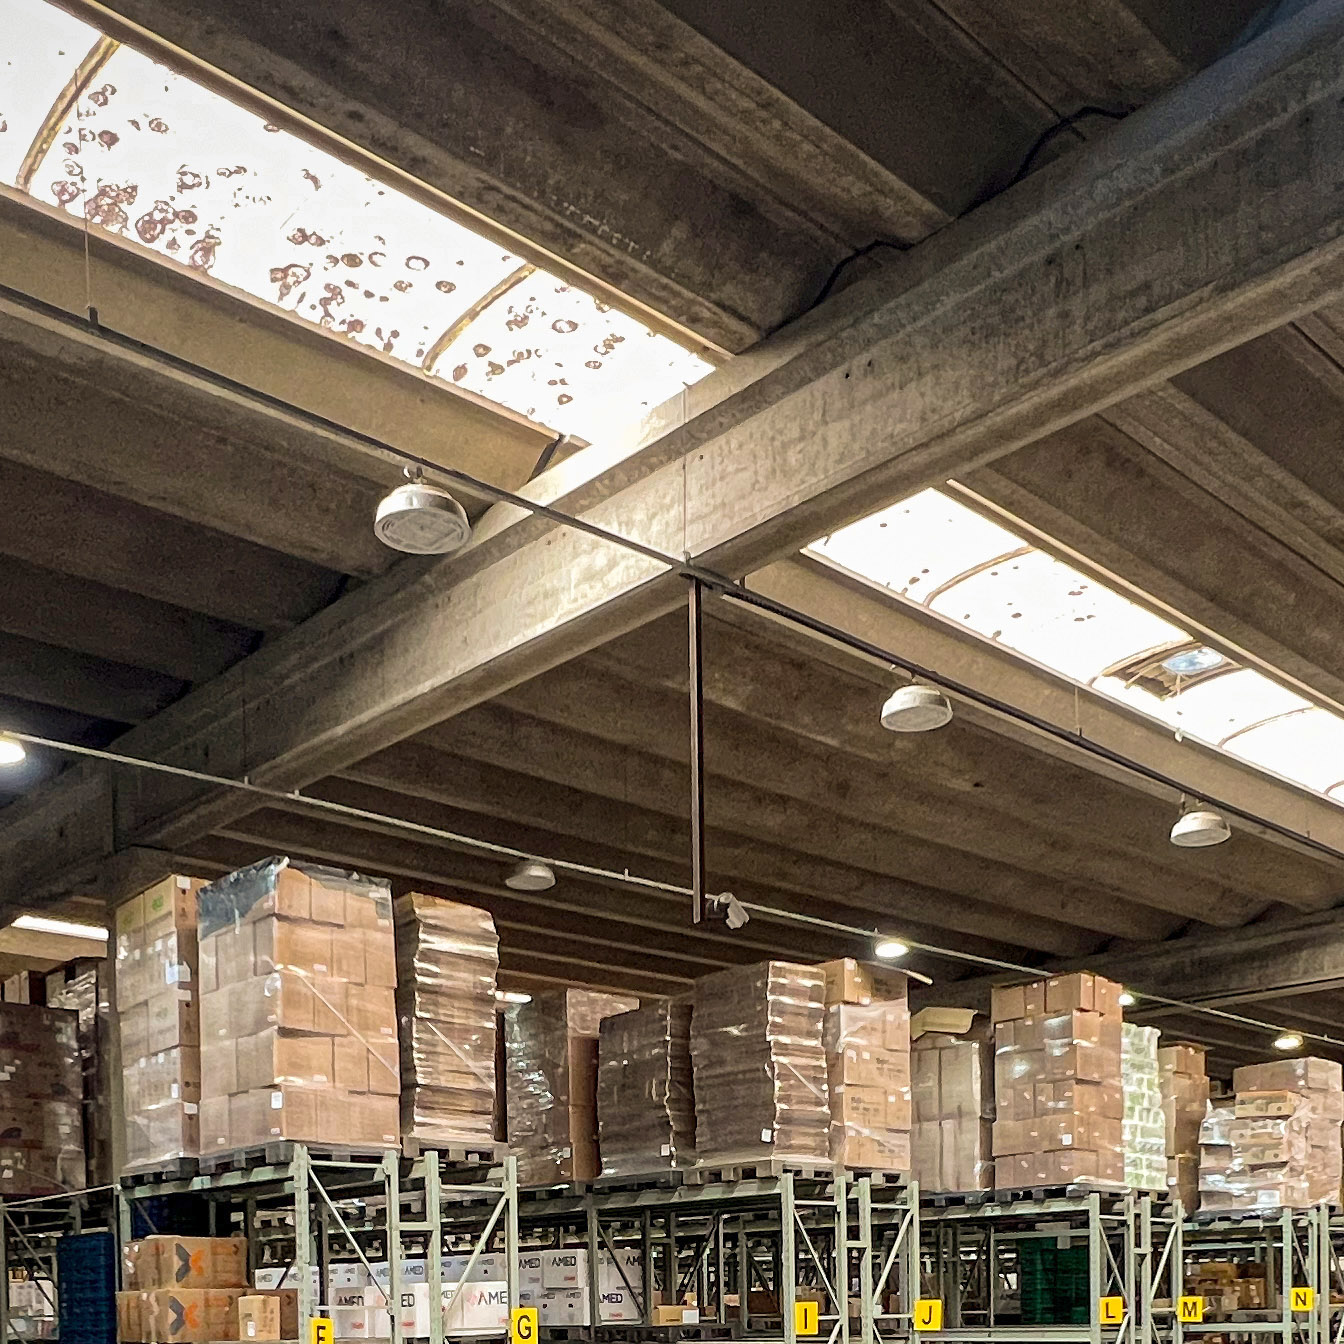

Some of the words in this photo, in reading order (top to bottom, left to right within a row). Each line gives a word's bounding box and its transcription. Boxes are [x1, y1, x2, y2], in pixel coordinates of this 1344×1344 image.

[477, 1290, 507, 1306] AME
[600, 1292, 624, 1304] MED
[1295, 1291, 1307, 1307] N
[921, 1305, 933, 1326] J
[1105, 1302, 1116, 1319] L
[1182, 1301, 1197, 1318] M
[517, 1314, 532, 1340] G
[803, 1307, 808, 1330] I
